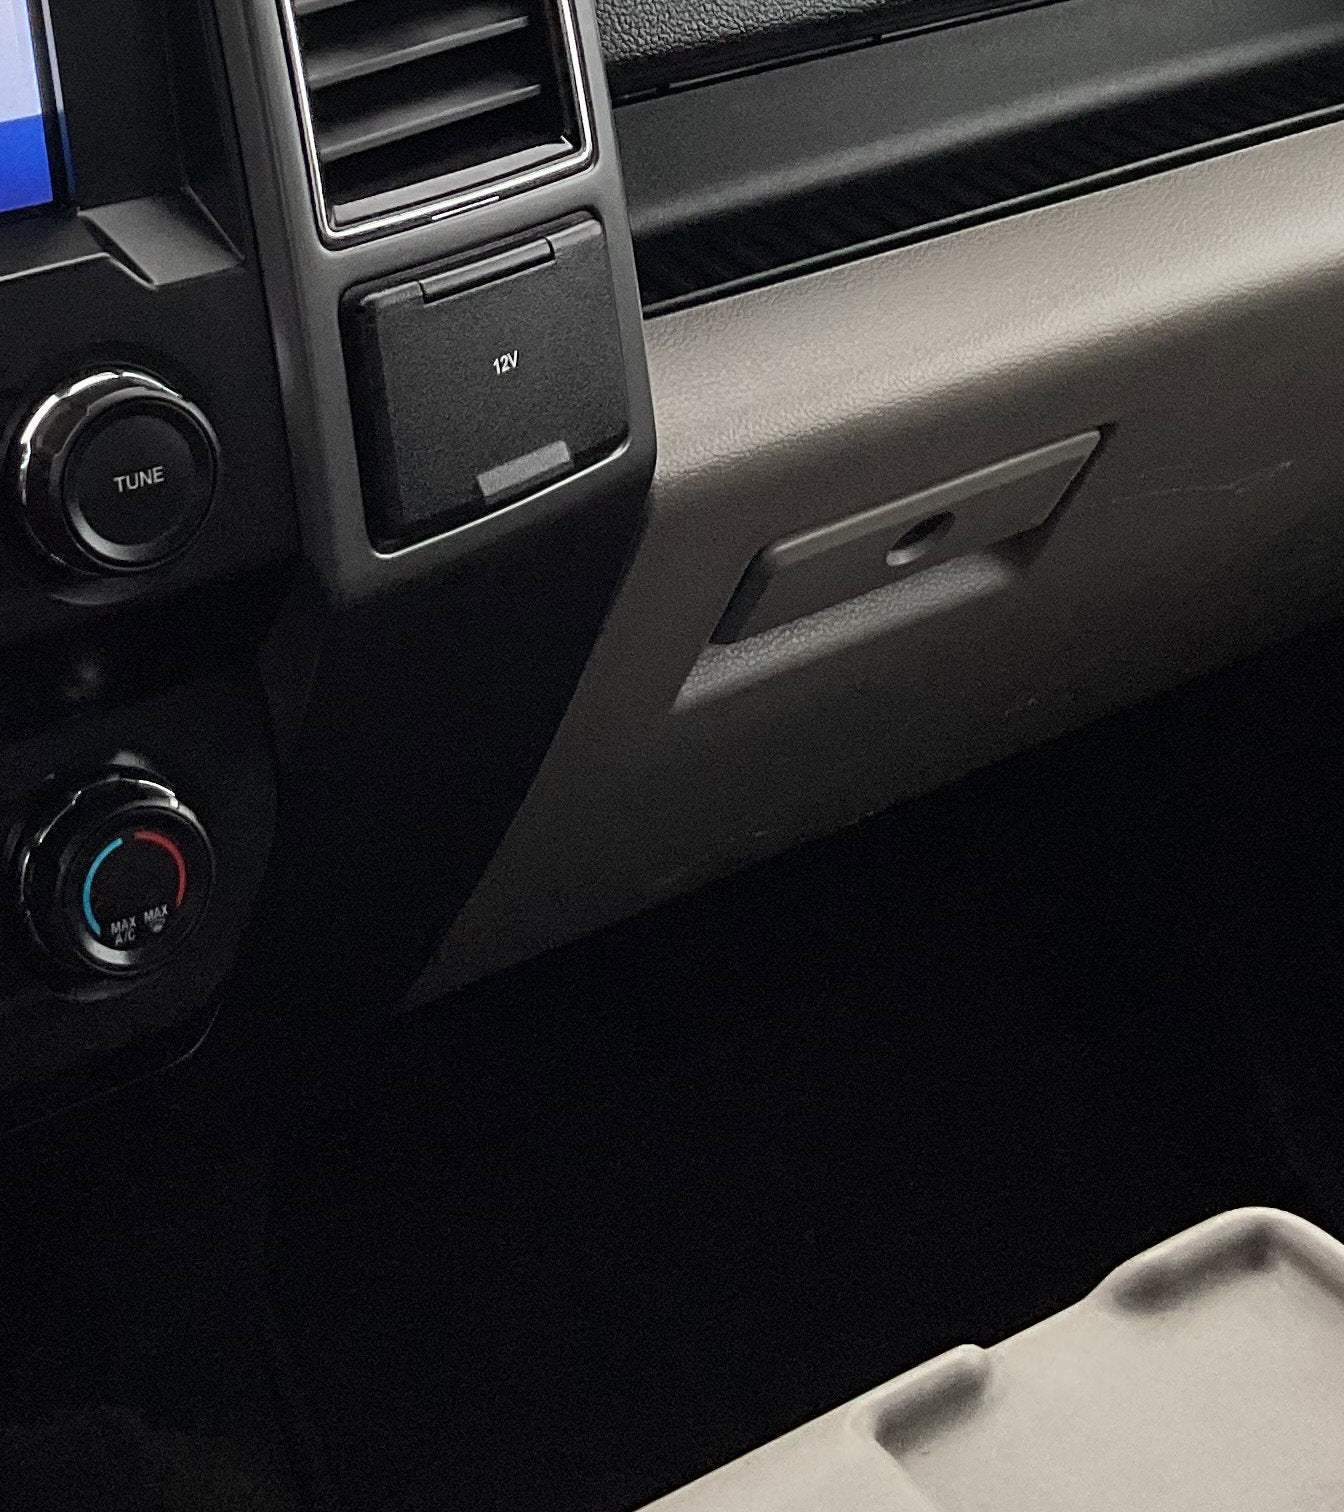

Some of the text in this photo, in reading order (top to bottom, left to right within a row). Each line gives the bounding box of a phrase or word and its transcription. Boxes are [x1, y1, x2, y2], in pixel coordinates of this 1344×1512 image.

[493, 350, 519, 375] 12V
[113, 466, 165, 493] TUNE
[111, 915, 136, 935] MAX
[144, 904, 168, 925] MAX
